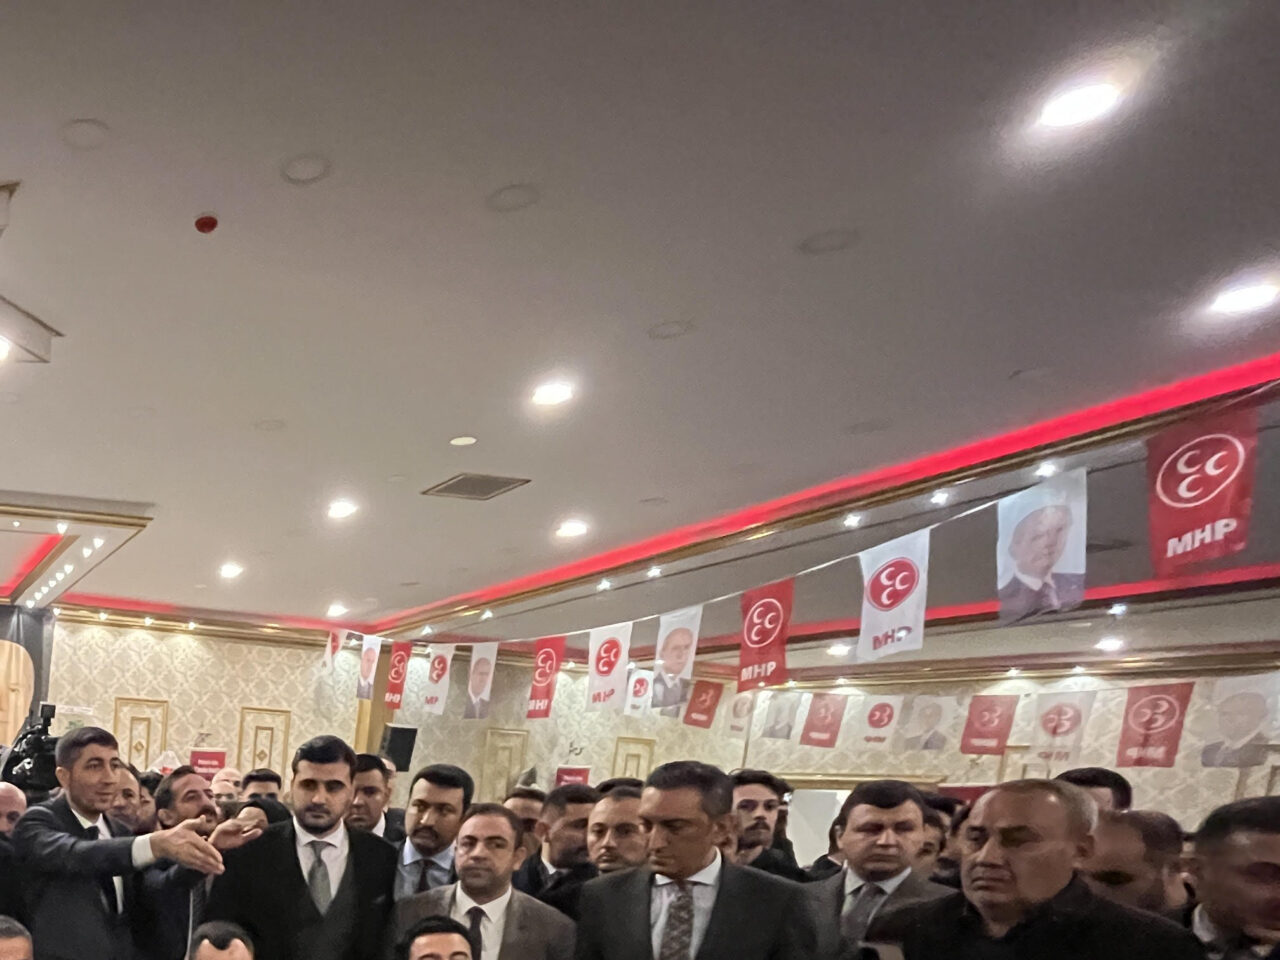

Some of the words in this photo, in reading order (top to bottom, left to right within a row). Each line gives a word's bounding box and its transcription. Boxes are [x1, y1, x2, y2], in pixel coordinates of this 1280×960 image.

[1165, 516, 1236, 558] MHP
[872, 626, 913, 652] MHP
[740, 660, 776, 682] MHP
